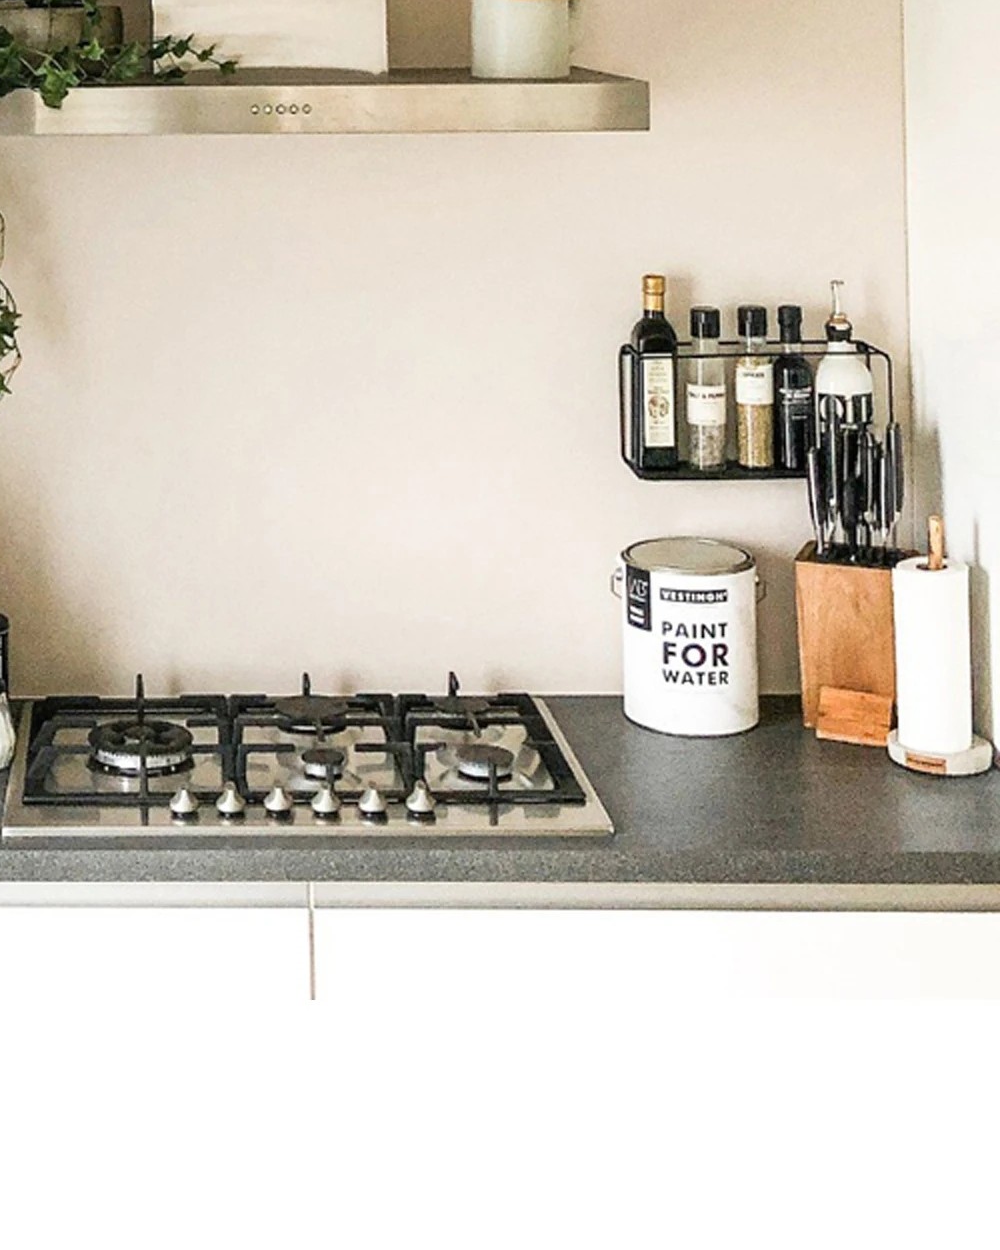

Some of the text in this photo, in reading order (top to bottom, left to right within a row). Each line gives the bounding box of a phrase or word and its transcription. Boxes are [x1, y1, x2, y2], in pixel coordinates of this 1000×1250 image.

[662, 620, 728, 639] PAINT
[663, 641, 729, 668] FOR
[662, 668, 729, 686] WATER
